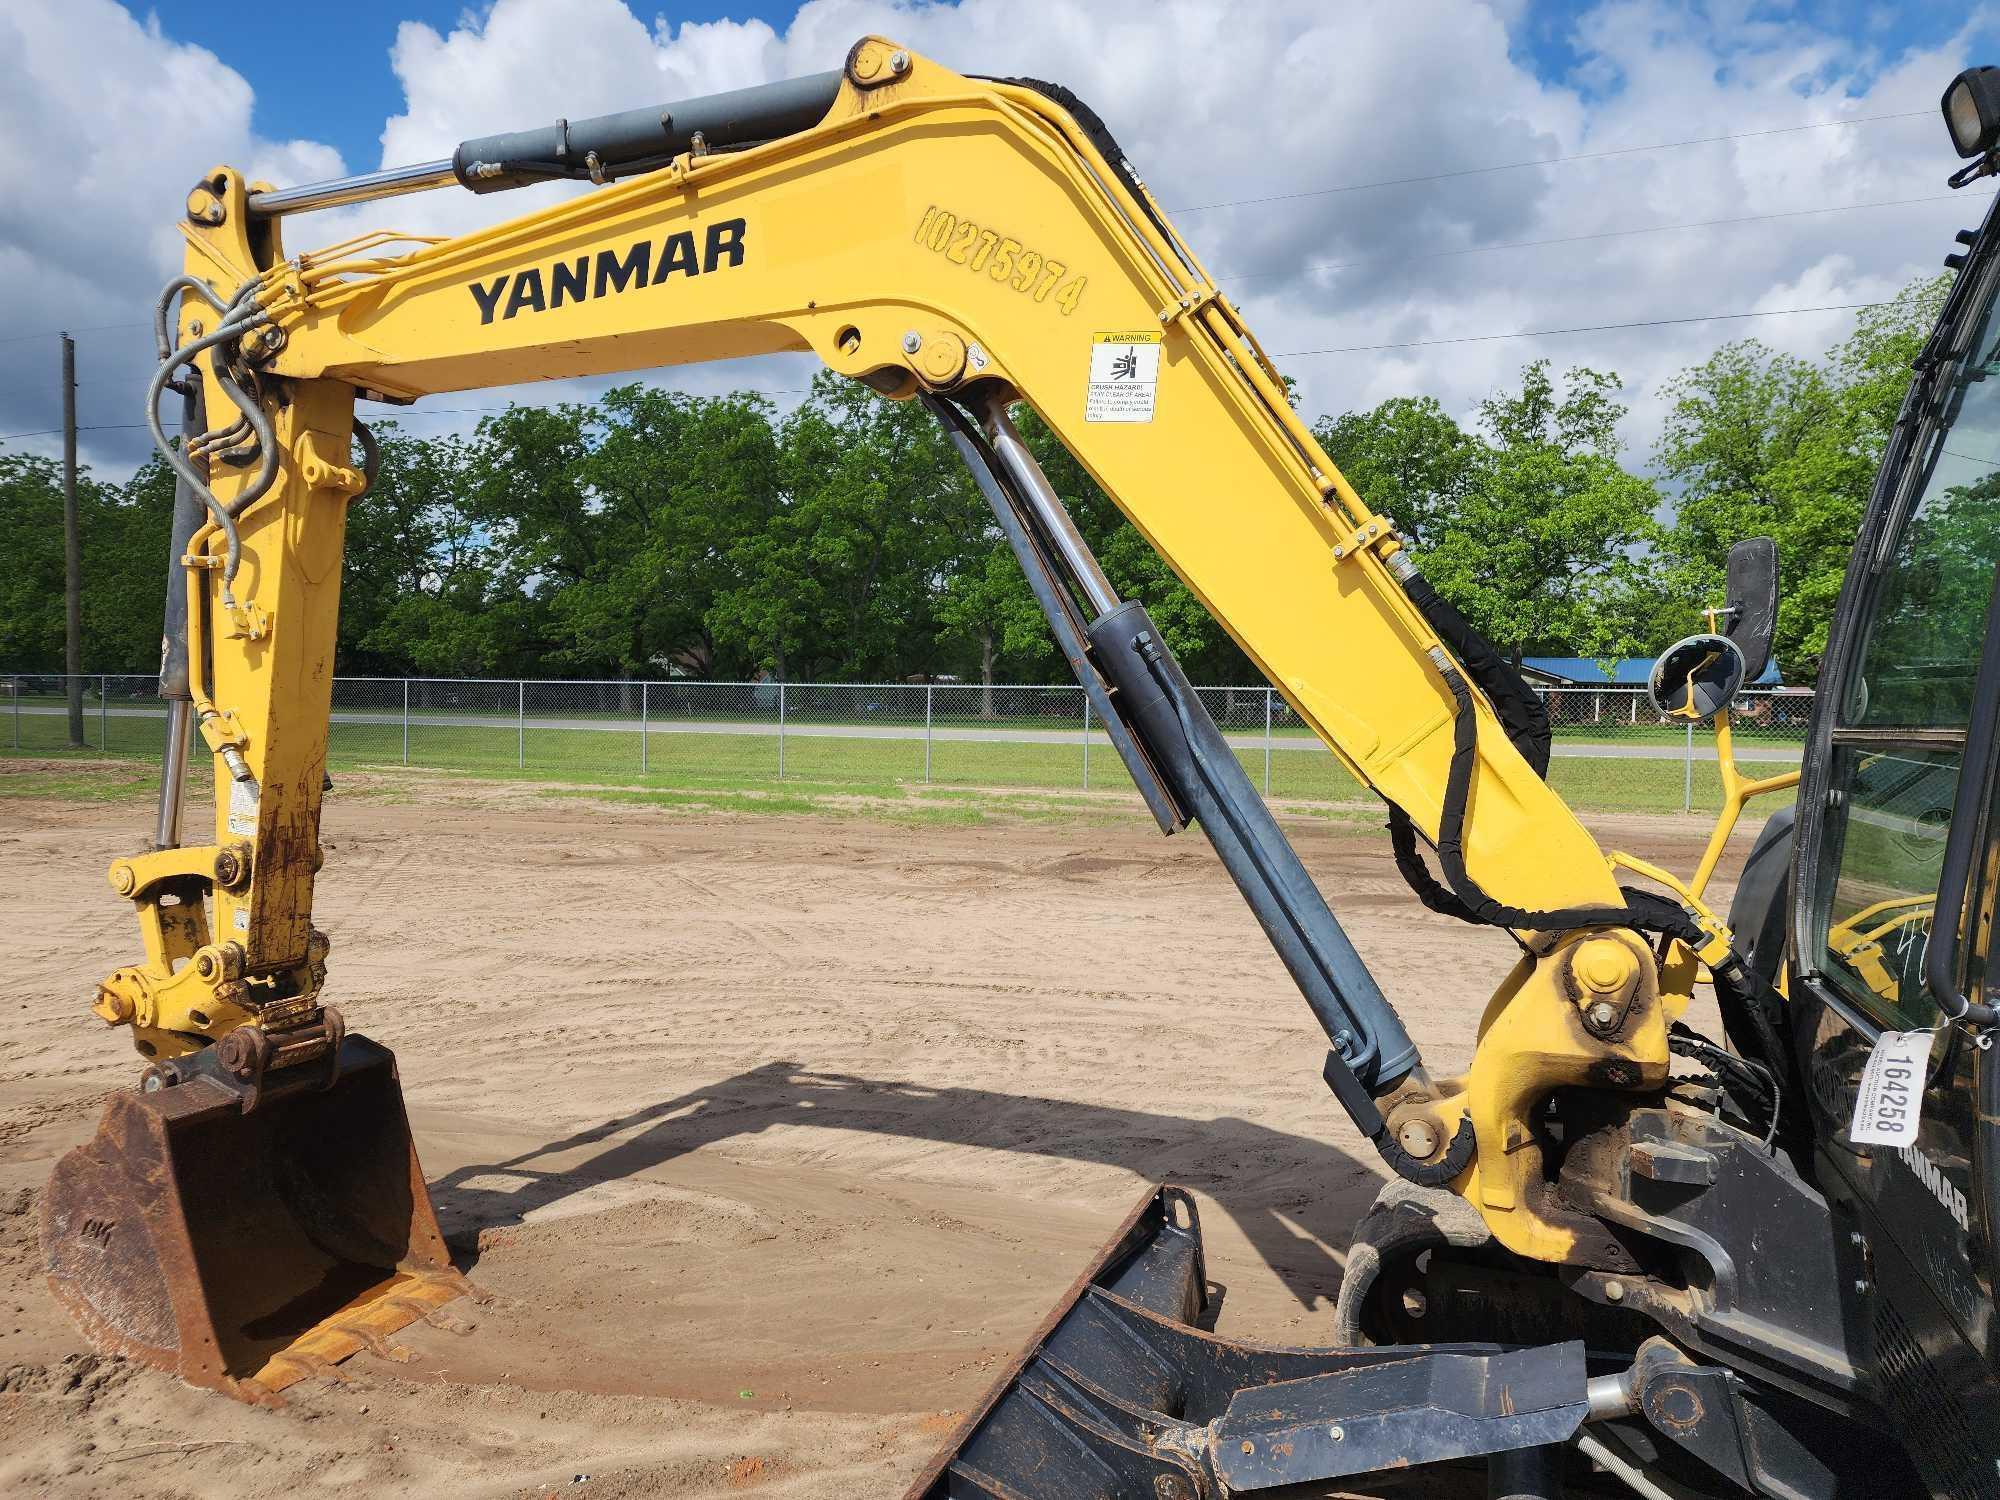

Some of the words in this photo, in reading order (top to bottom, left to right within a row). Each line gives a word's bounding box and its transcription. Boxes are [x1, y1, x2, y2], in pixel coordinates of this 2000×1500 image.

[469, 217, 746, 325] YANMAR
[914, 205, 1088, 316] 10275974
[1112, 334, 1151, 342] WARNING
[1875, 1055, 1914, 1133] 164258
